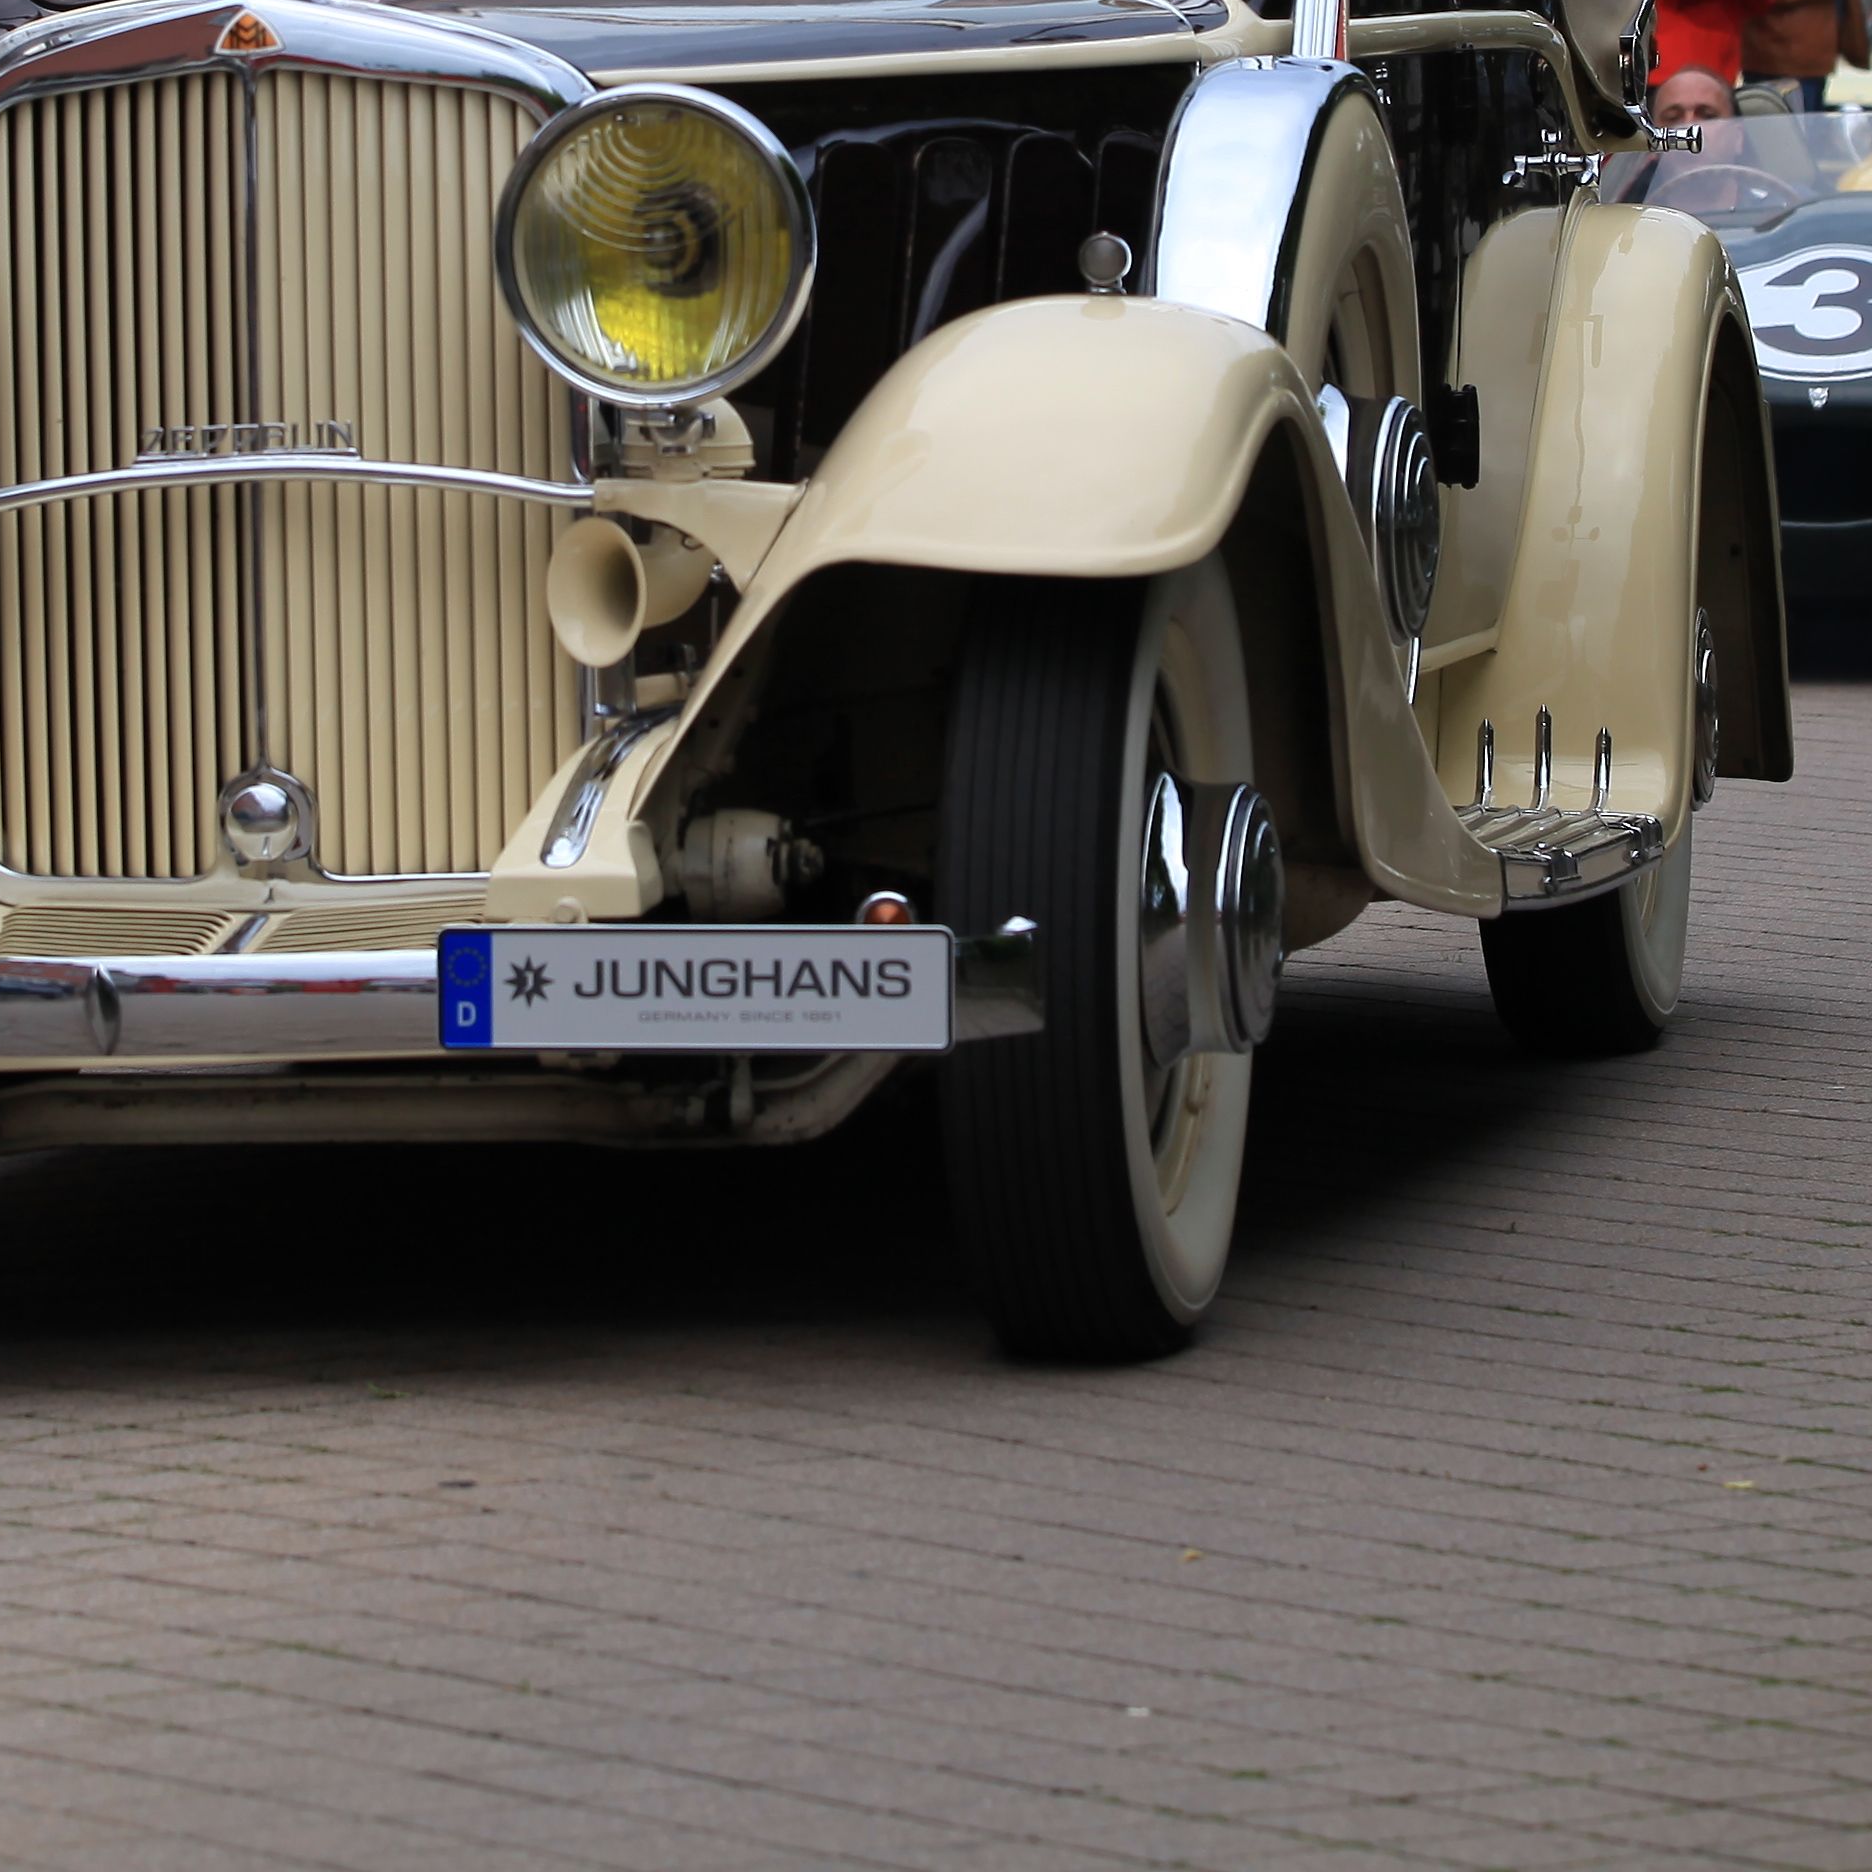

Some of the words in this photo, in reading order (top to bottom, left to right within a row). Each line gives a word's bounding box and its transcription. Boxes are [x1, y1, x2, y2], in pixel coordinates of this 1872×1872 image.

[140, 419, 355, 456] ZEPPELIN
[574, 958, 913, 1000] JUNGHANS
[457, 1001, 477, 1027] D
[739, 1010, 794, 1024] SINCE
